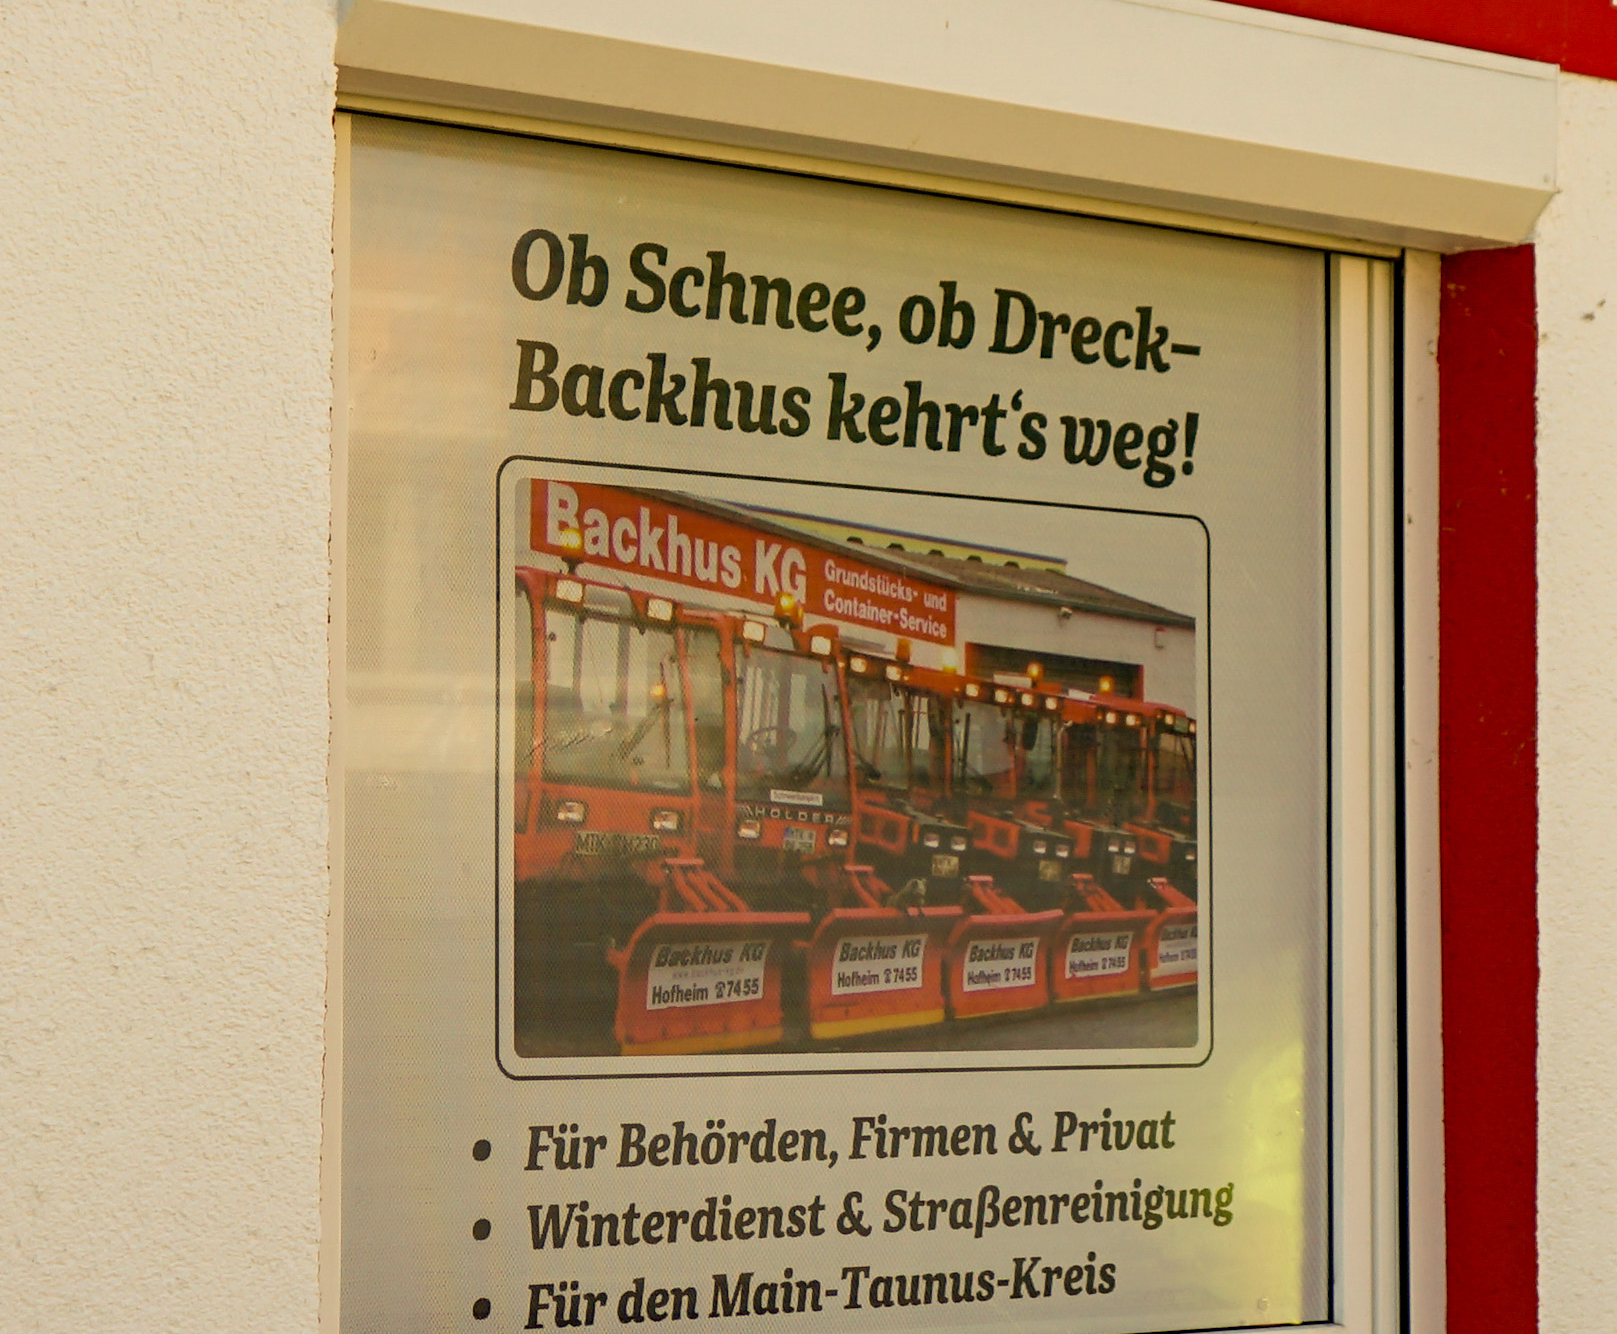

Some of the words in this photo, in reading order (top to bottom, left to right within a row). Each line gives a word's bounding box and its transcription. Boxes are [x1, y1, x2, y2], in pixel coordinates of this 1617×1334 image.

[511, 228, 609, 308] Ob
[625, 242, 882, 353] Schnee,
[899, 281, 976, 349] ob
[510, 339, 811, 439] Backhus
[1061, 411, 1200, 489] weg!
[546, 481, 742, 589] Backhus
[754, 539, 807, 605] KG
[823, 588, 947, 640] Container-Service
[824, 559, 918, 601] Grundstücks-
[923, 593, 948, 612] und
[655, 944, 734, 967] Backhus
[837, 970, 880, 988] Hofheim
[839, 940, 897, 962] Backhus
[902, 938, 922, 958] KG
[652, 982, 708, 1005] Hofheim
[524, 1124, 607, 1172] Für
[616, 1118, 838, 1170] Behörden,
[849, 1113, 998, 1160] Firmen
[1007, 1111, 1043, 1157] &
[1051, 1108, 1175, 1154] Privat
[527, 1194, 825, 1251] Winterdienst
[836, 1191, 873, 1237] &
[882, 1178, 1235, 1241] Straßenreinigung
[523, 1282, 608, 1330] Für
[616, 1277, 699, 1326] den
[708, 1251, 1118, 1320] Main-Taunus-Kreis
